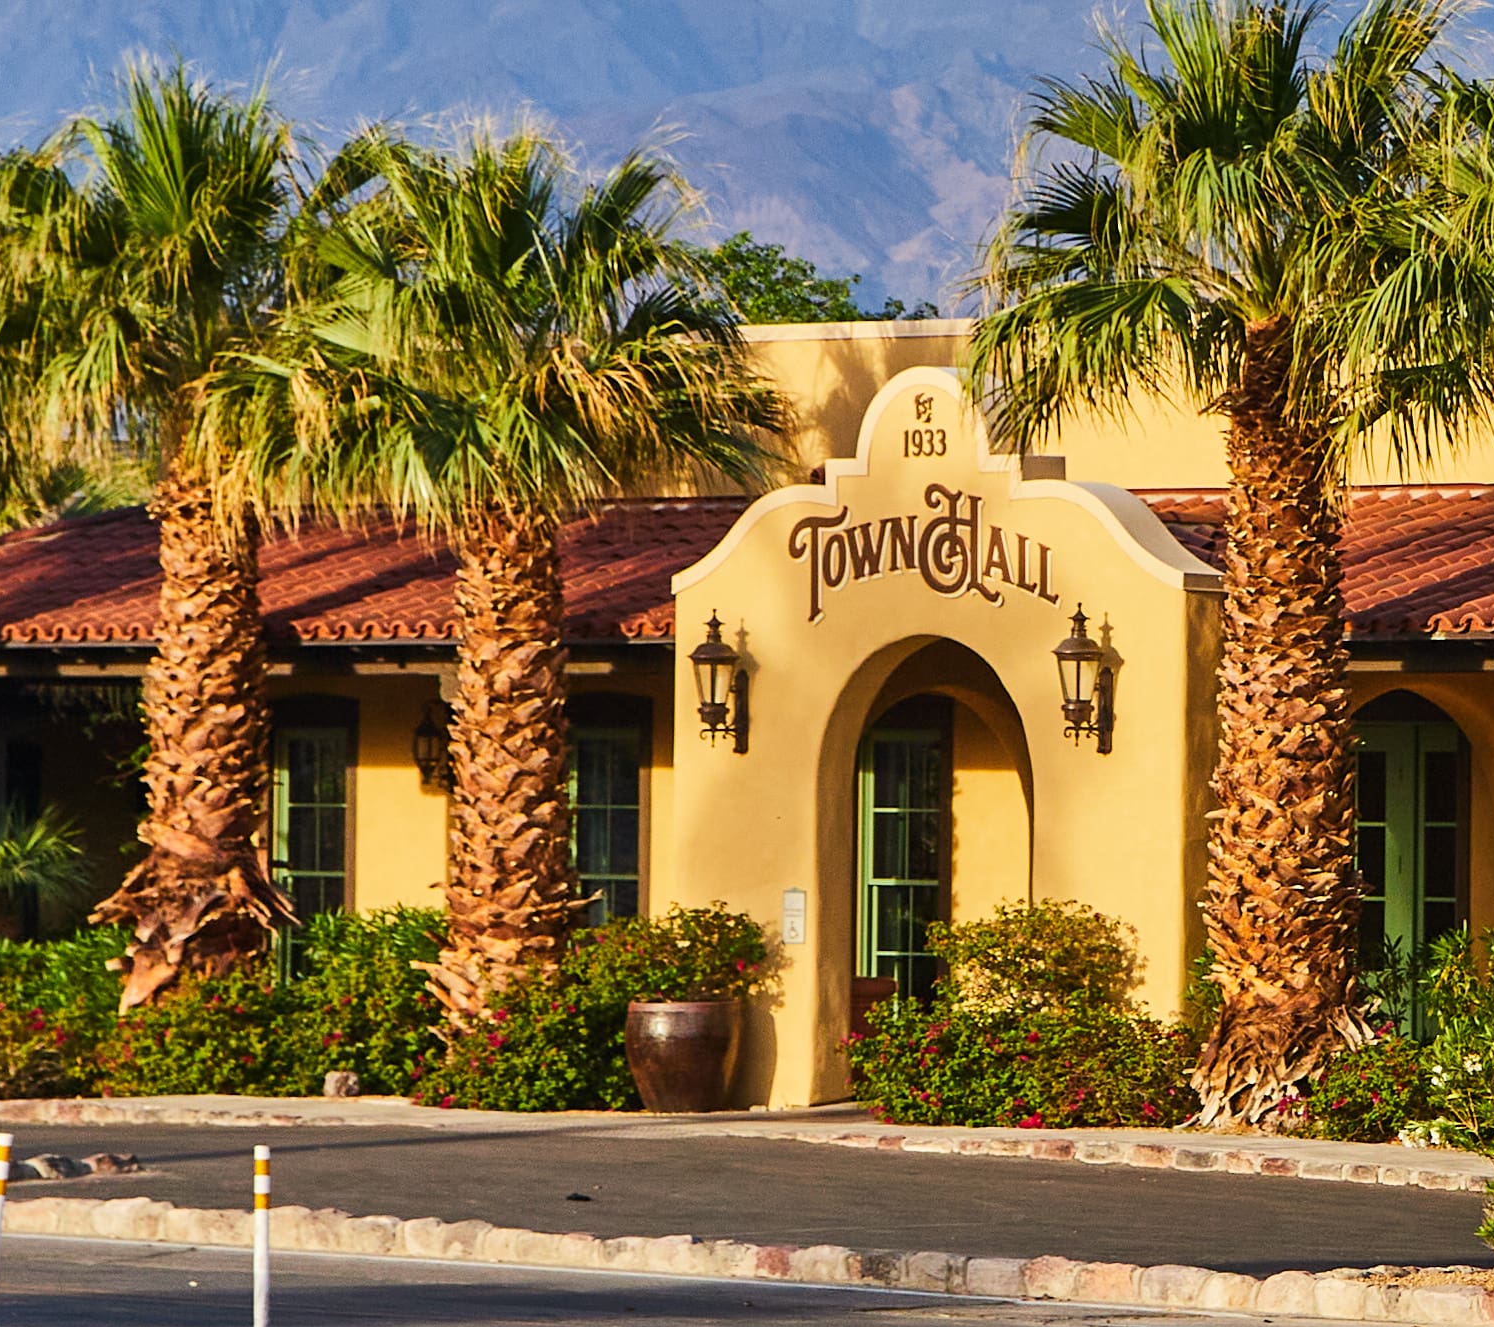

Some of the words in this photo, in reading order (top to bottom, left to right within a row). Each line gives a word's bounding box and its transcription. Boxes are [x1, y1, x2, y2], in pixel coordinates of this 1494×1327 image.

[903, 429, 947, 458] 1933
[788, 505, 920, 626] TOWN
[918, 483, 1062, 609] HALL
